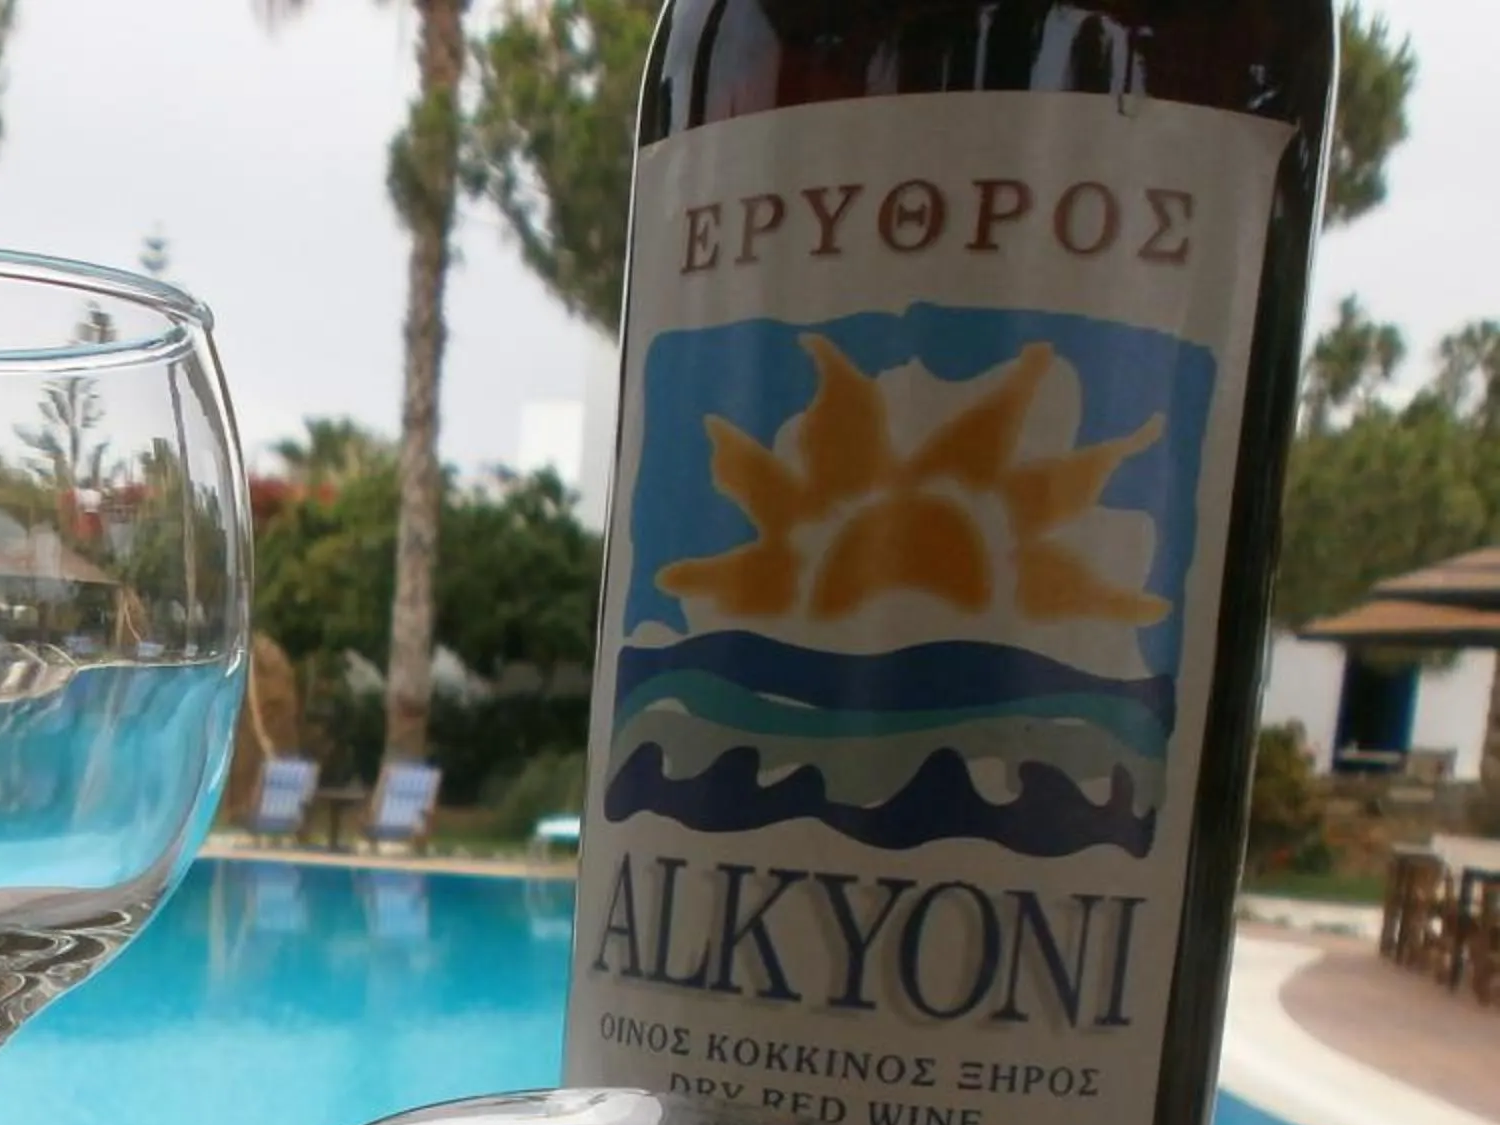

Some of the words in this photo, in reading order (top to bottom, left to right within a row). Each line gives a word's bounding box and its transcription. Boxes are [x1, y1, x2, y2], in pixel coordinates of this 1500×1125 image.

[680, 179, 1194, 275] ΕΡΥΘΡΟΣ
[593, 853, 1147, 1026] ALKYONI
[600, 1012, 691, 1056] ΟΙΝΟΣ
[705, 1034, 936, 1088] ΚΟΚΚΙΝΟΣ
[958, 1062, 1100, 1097] ΞΗΡΟΣ
